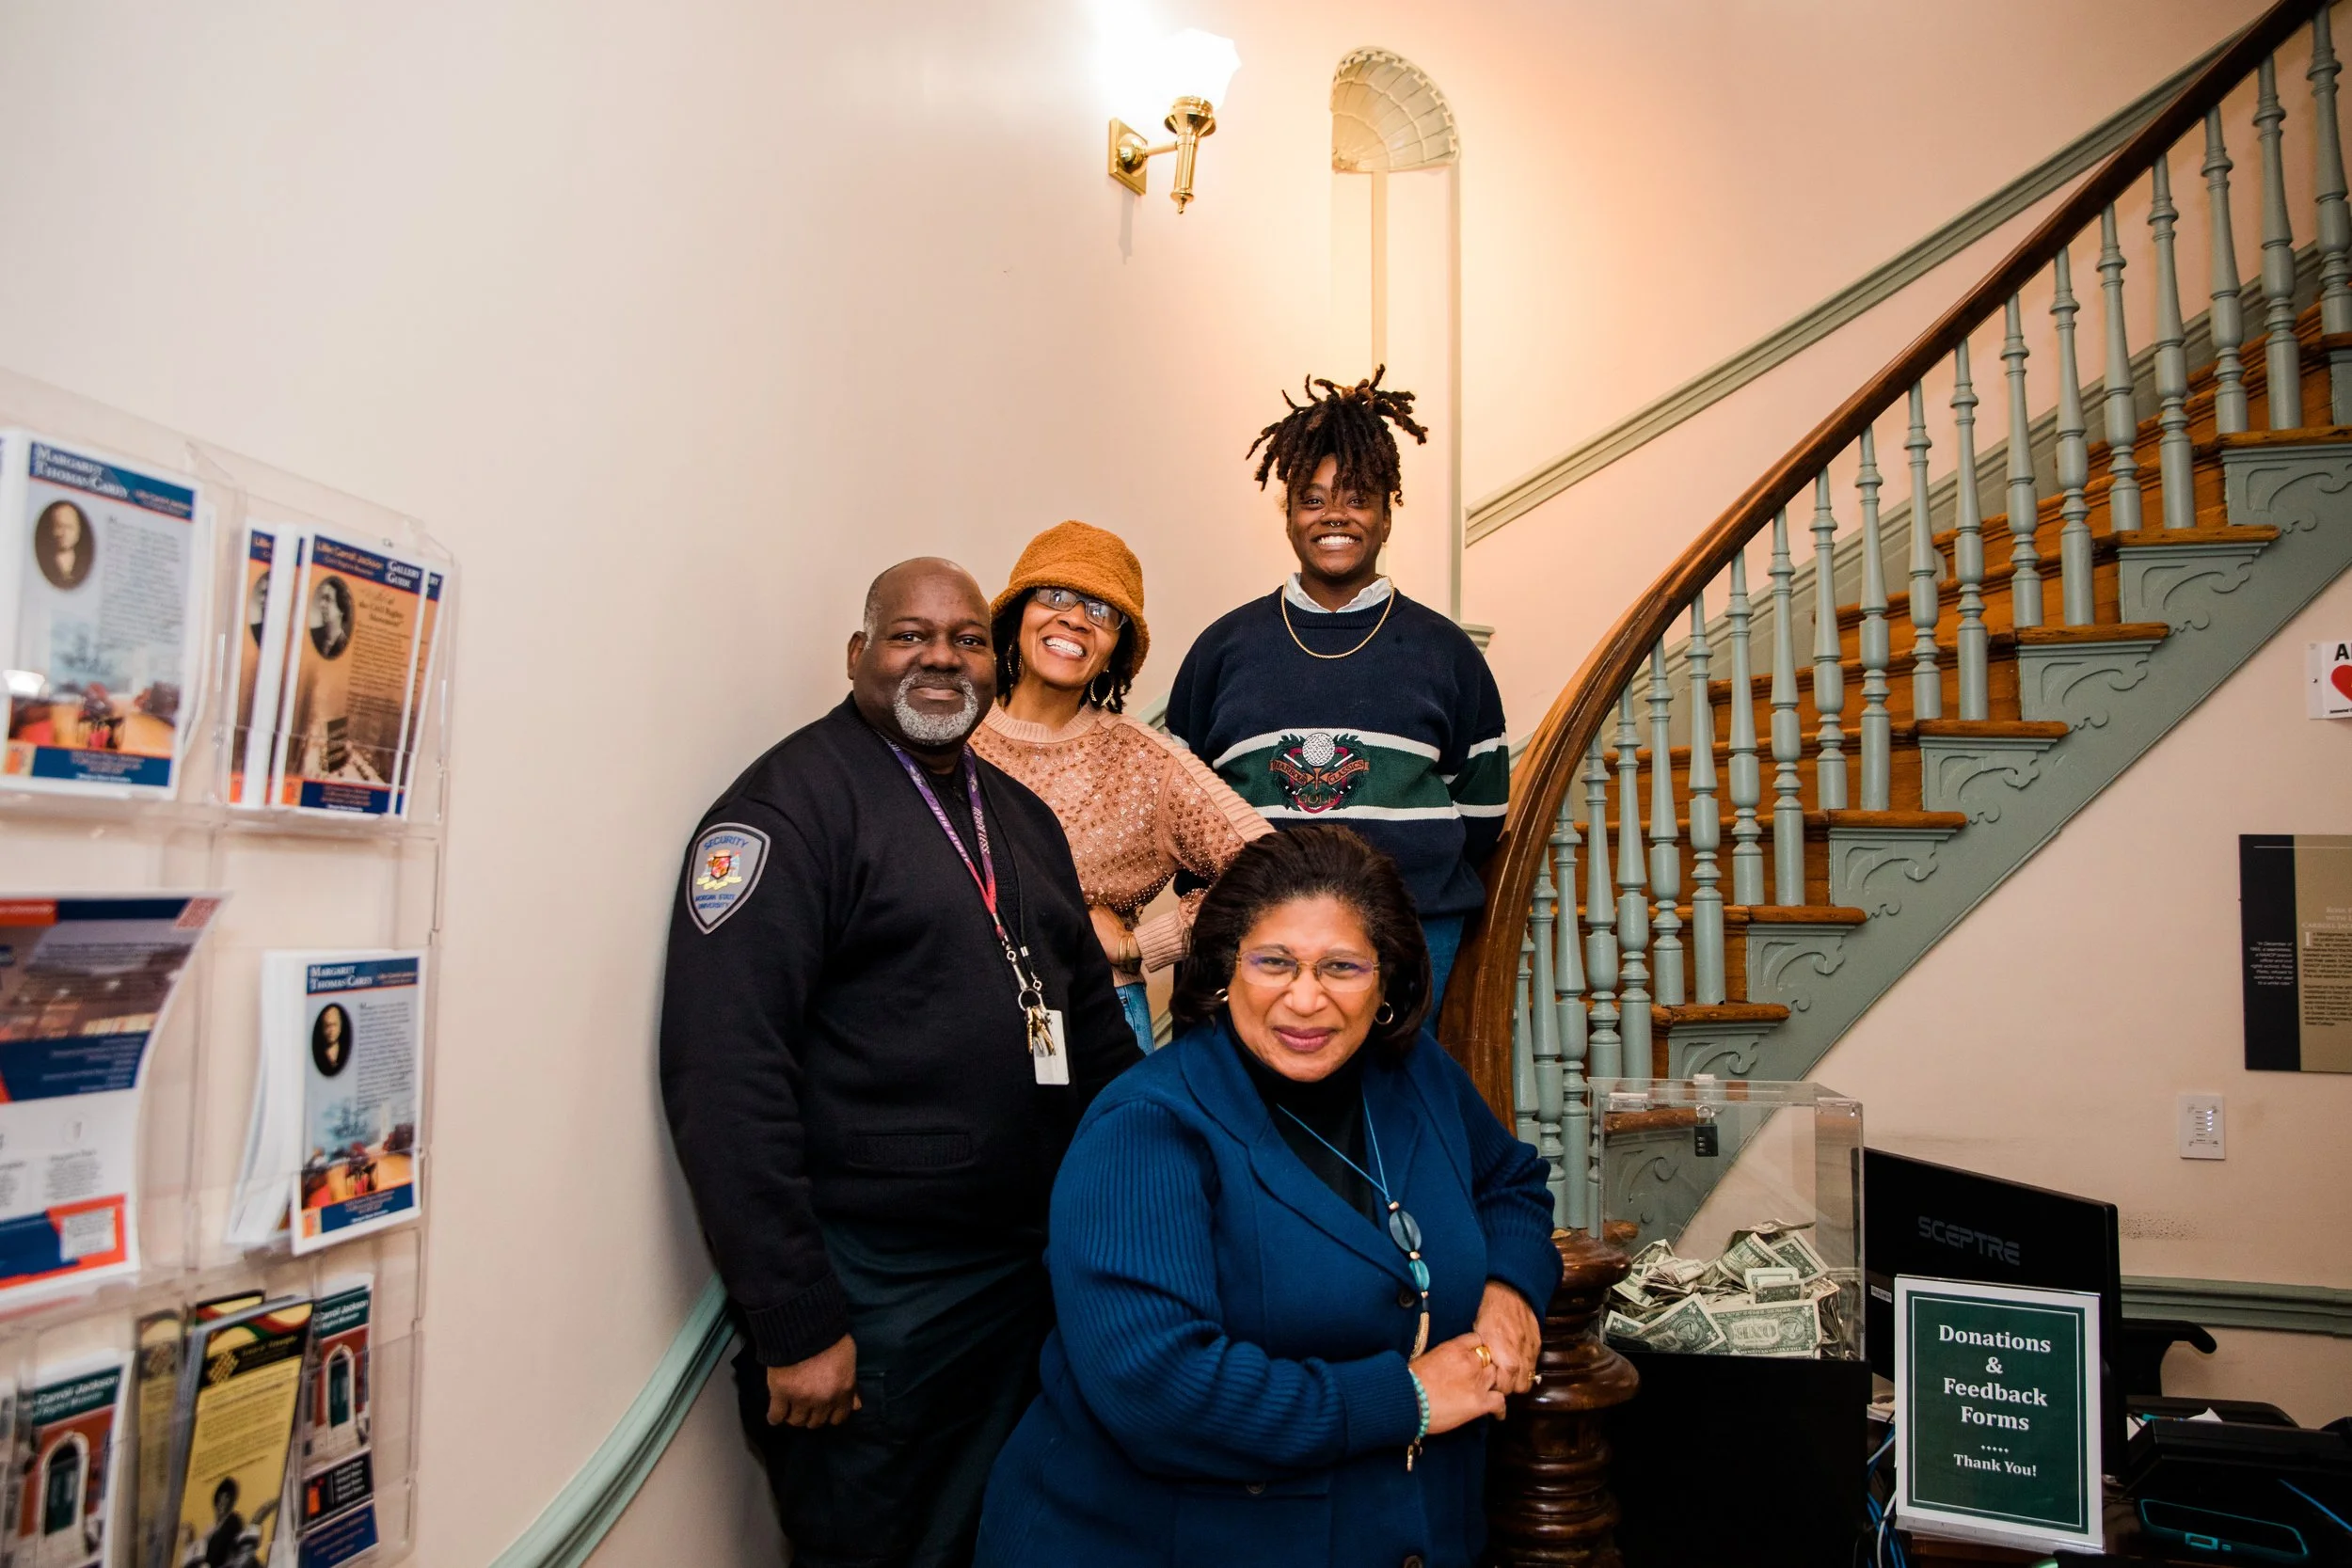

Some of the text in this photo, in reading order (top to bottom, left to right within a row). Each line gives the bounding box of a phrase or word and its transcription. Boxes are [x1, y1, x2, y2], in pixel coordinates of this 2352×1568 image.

[387, 560, 421, 578] GALLERY
[386, 571, 411, 588] GUIDE
[1328, 761, 1364, 784] CLASSICS
[704, 835, 749, 850] SECURITY
[310, 965, 357, 977] MARGARET
[1917, 1215, 2021, 1266] SCEPTRE
[1938, 1324, 2051, 1354] Donations
[1985, 1356, 2004, 1374] &
[75, 1375, 120, 1393] Jackson
[1943, 1377, 2048, 1407] Feedback
[1961, 1405, 2030, 1431] Forms
[1953, 1453, 2037, 1478] Thank You!
